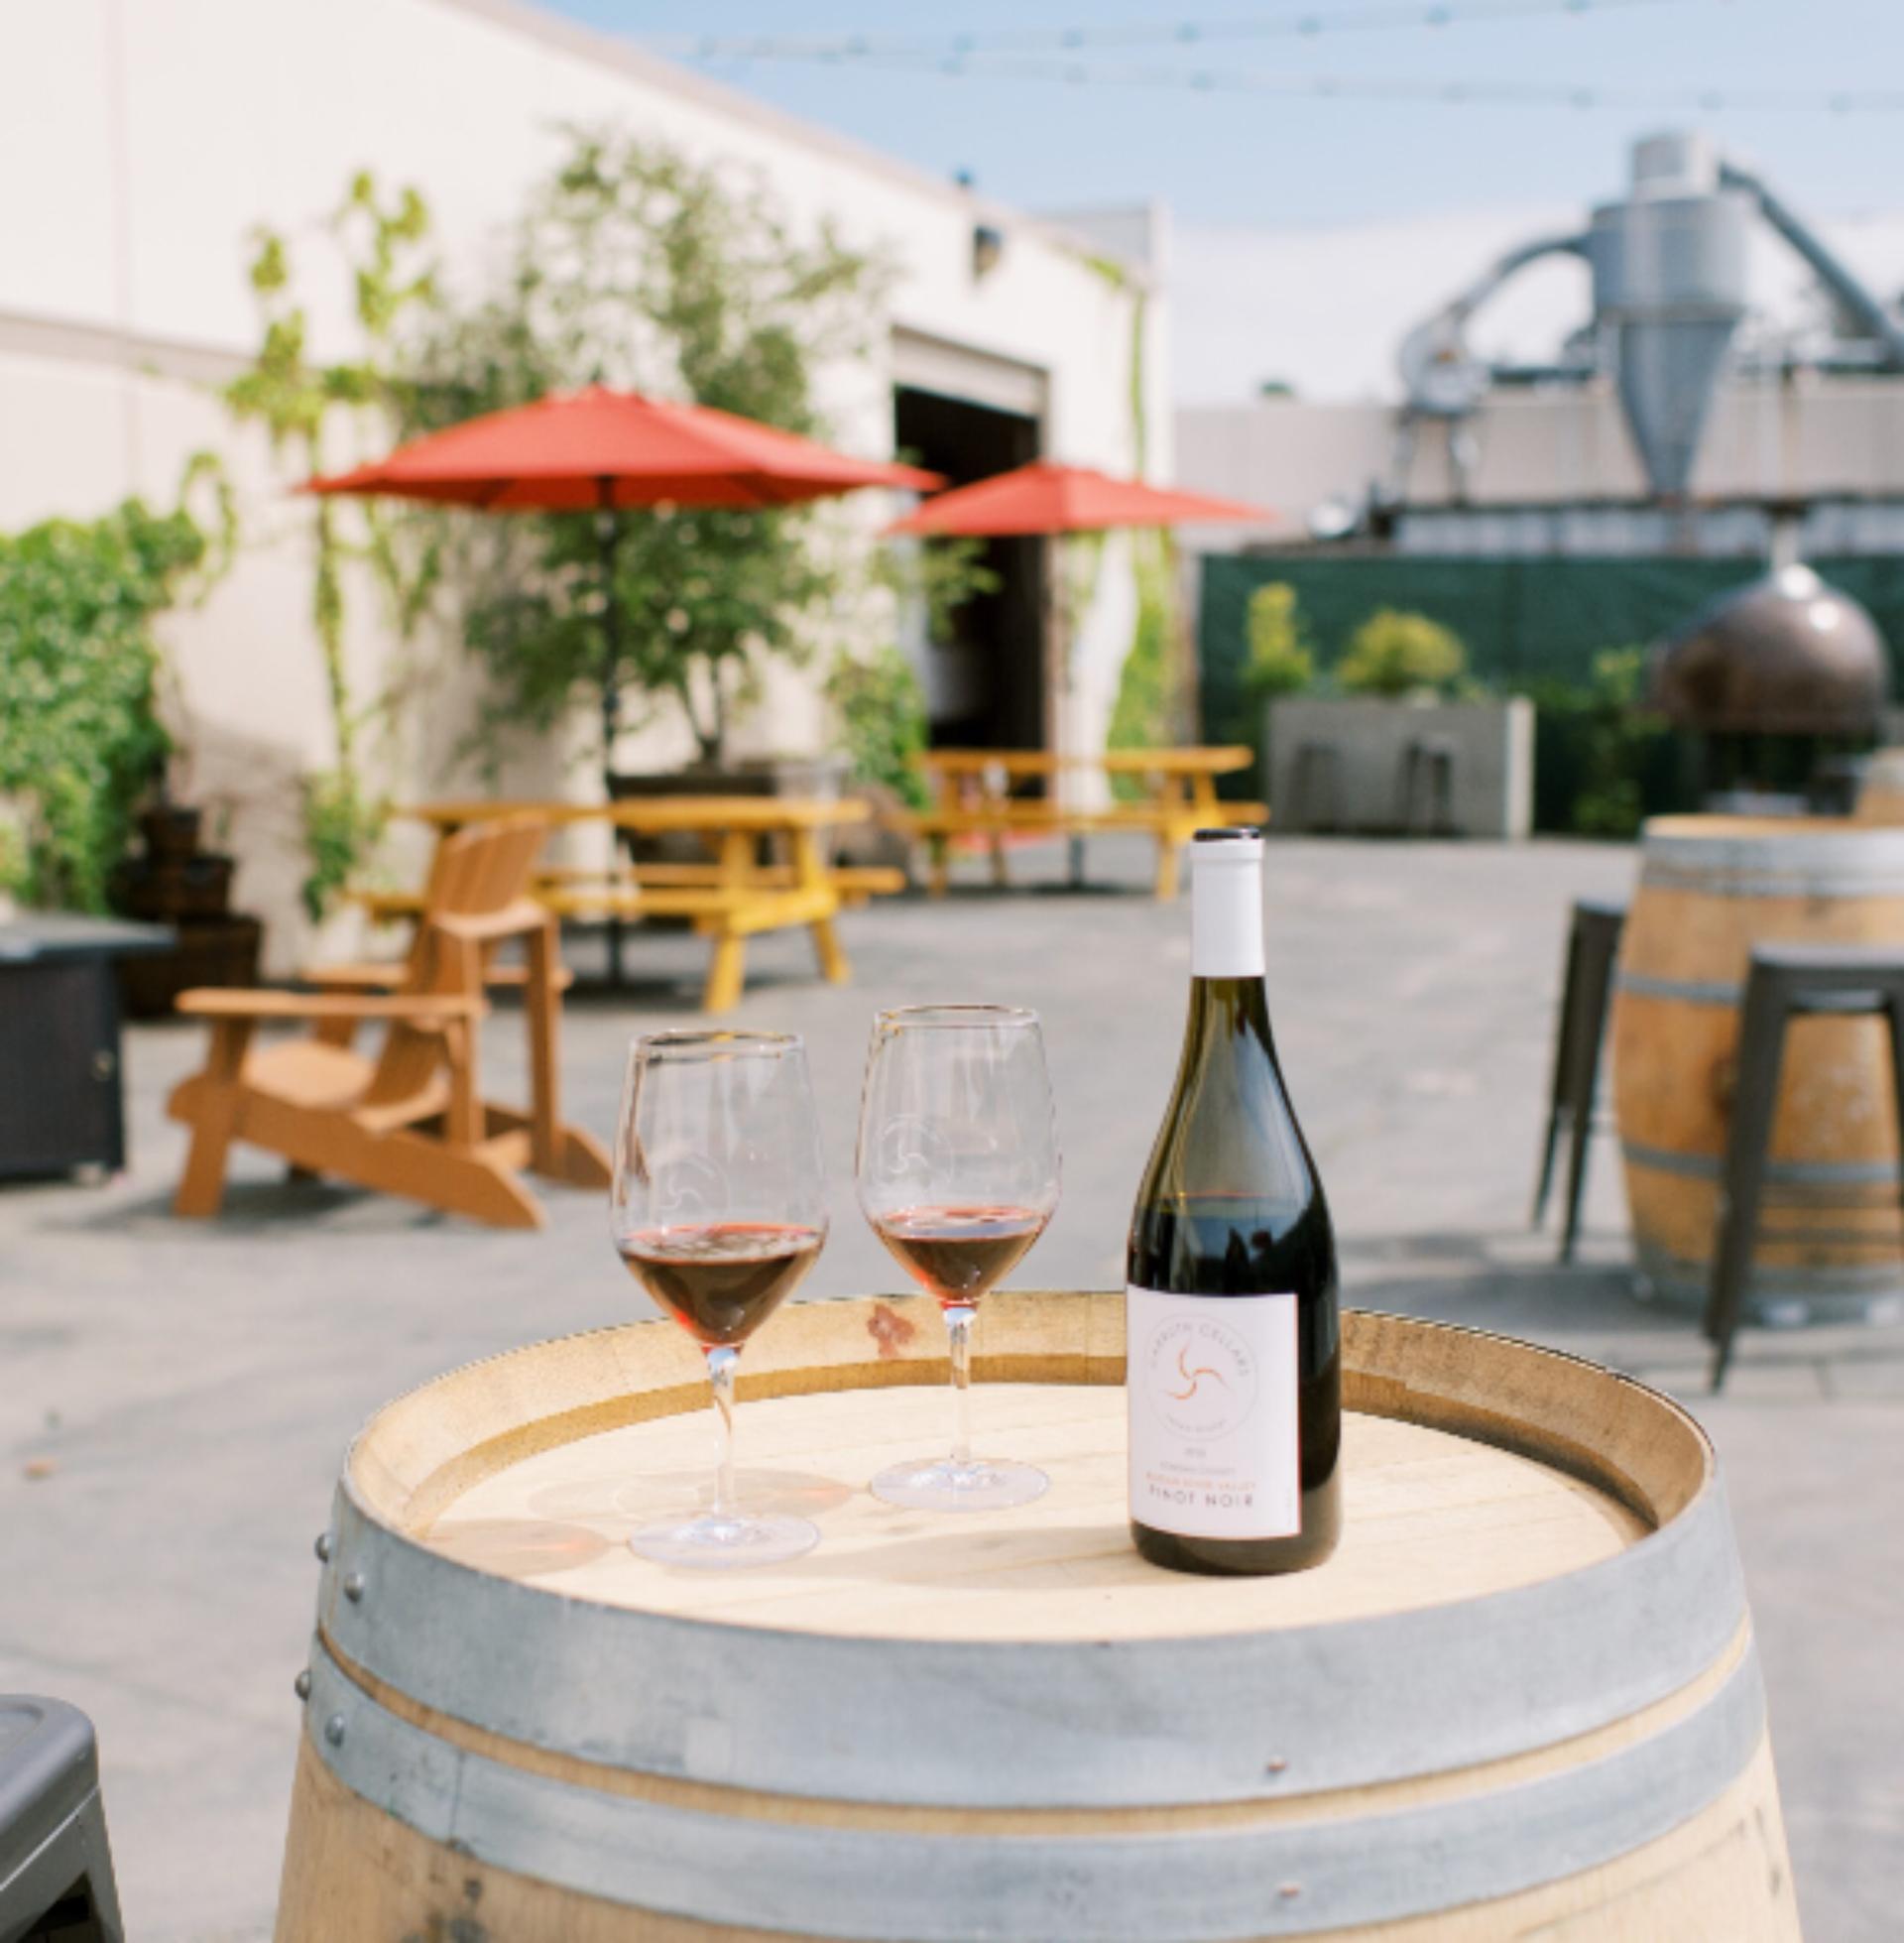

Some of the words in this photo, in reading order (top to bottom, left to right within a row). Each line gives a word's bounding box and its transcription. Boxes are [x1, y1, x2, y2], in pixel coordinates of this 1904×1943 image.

[1198, 1322, 1250, 1377] CELLARS
[1148, 1483, 1195, 1505] PINOT
[1205, 1493, 1253, 1509] NOIR
